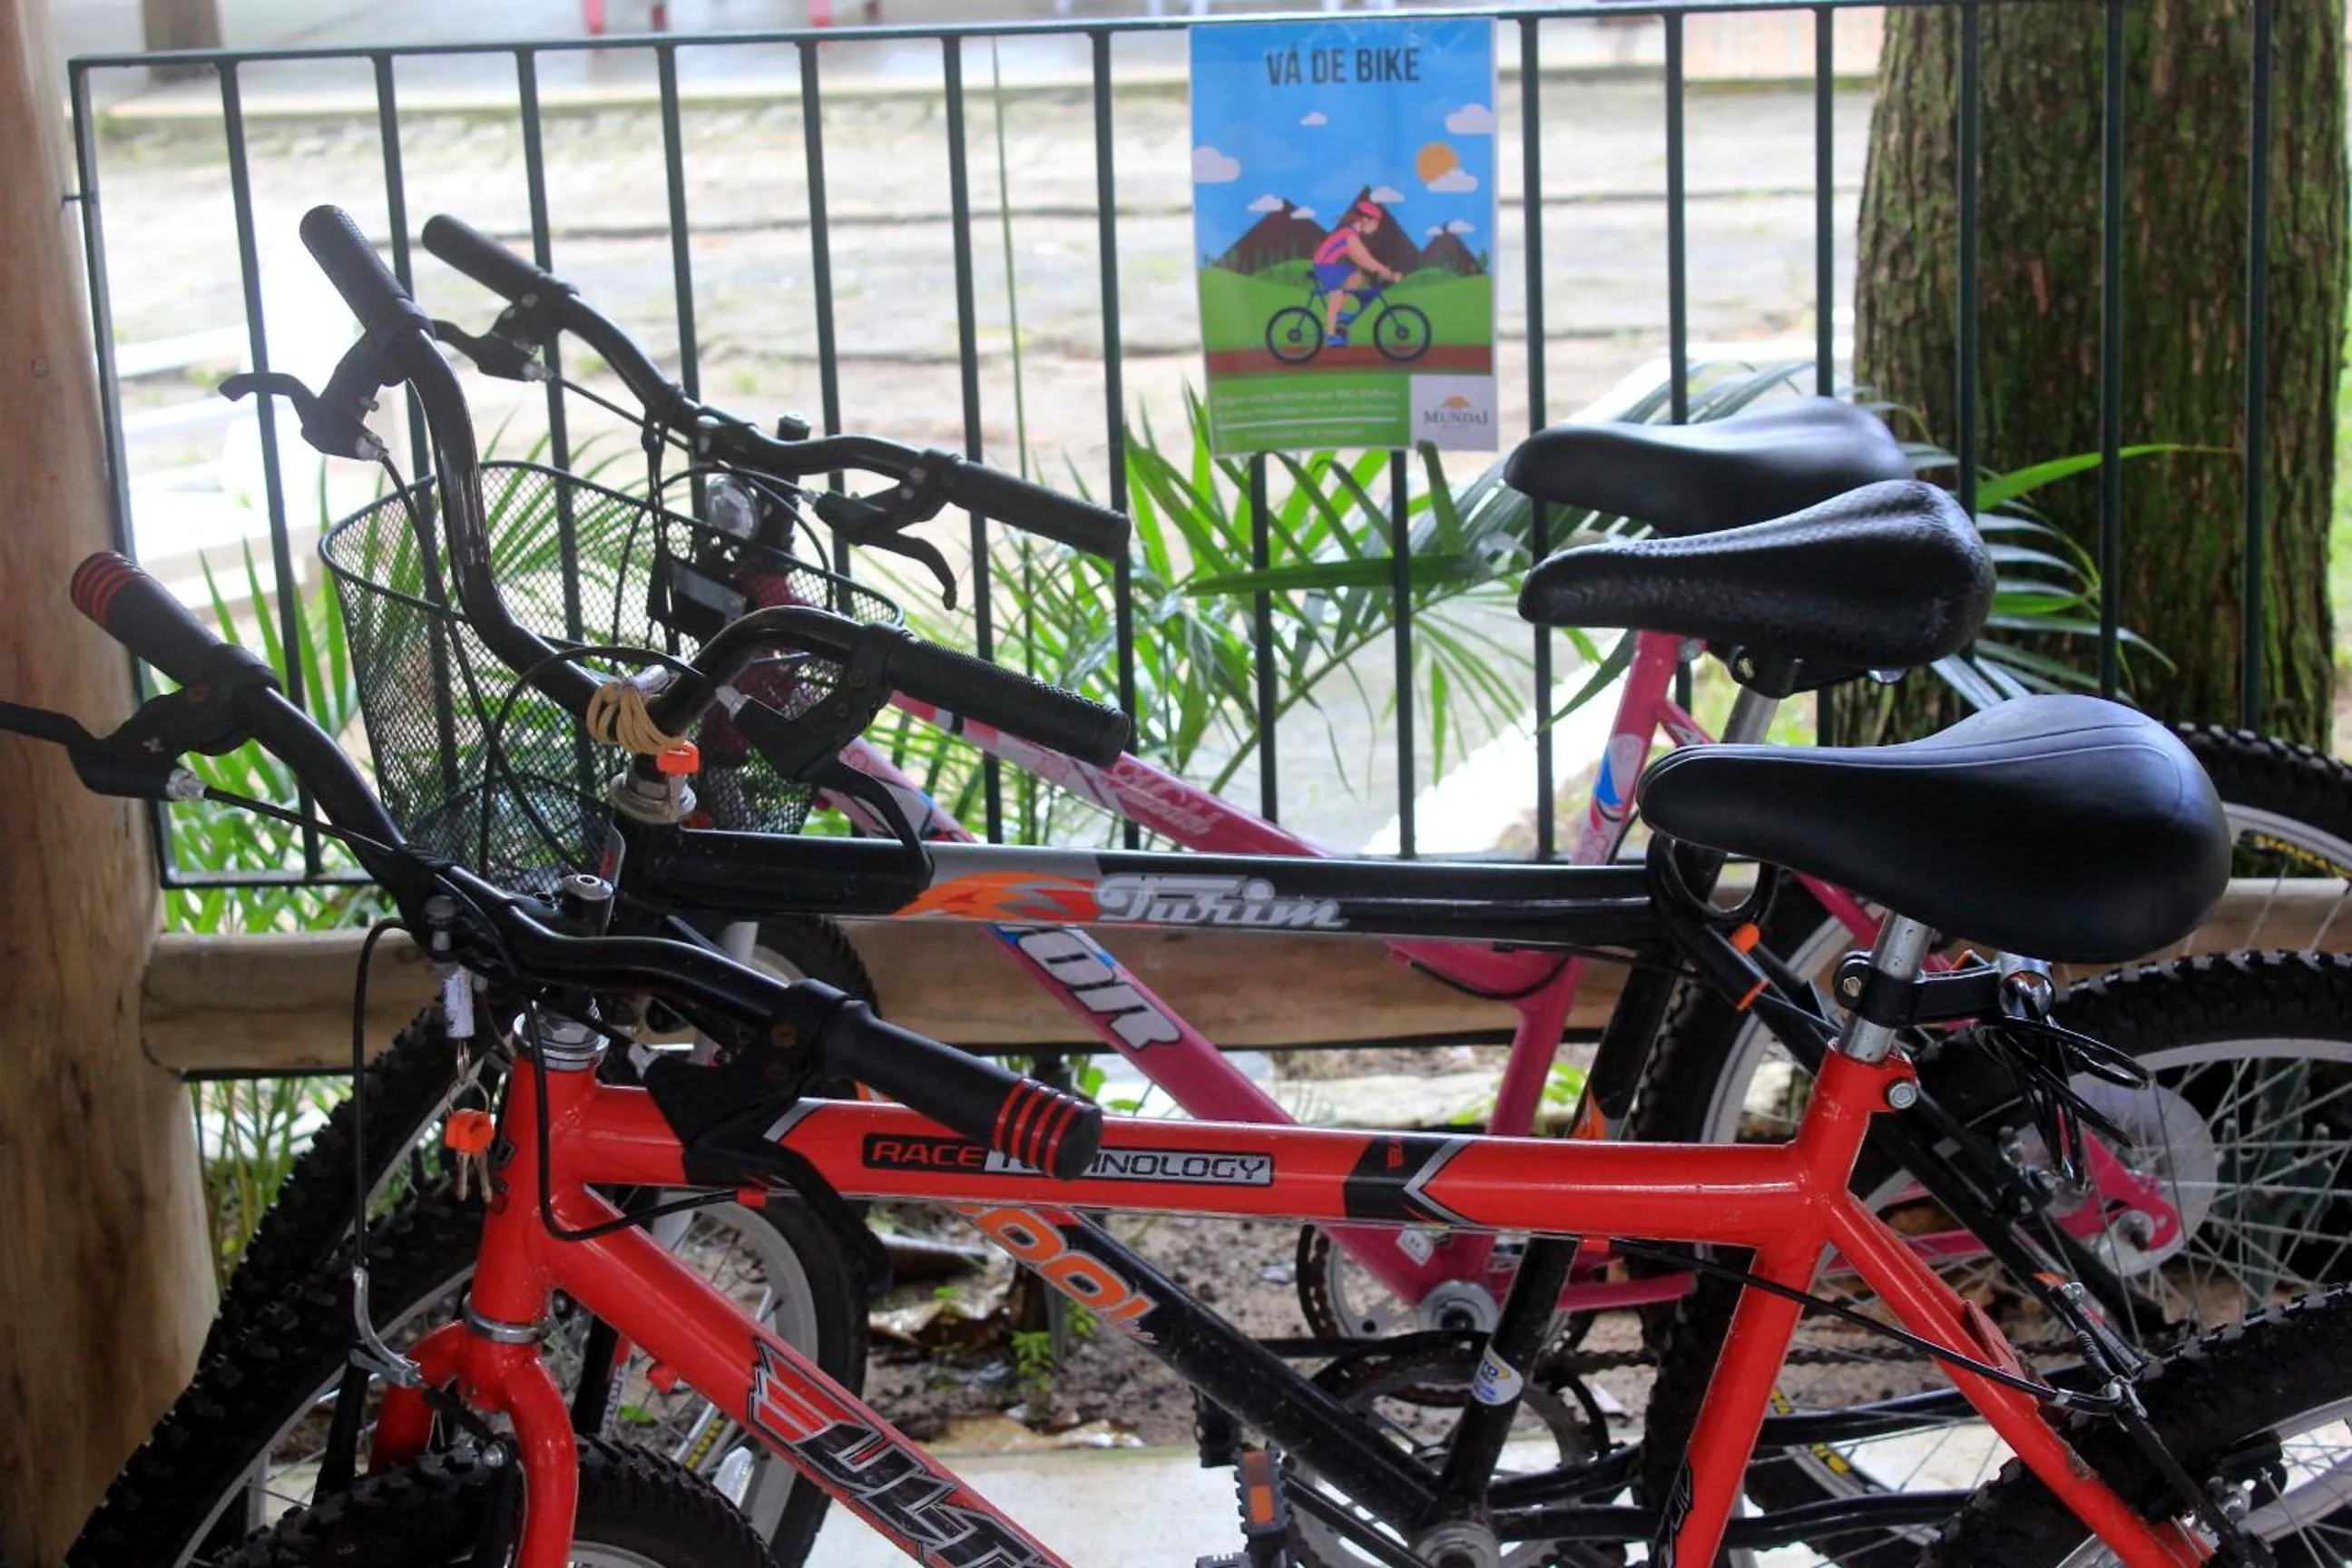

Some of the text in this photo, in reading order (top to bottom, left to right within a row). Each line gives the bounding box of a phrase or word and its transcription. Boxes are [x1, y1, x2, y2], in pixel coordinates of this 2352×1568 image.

[1266, 42, 1421, 86] VÁ DE BIKE
[1093, 873, 1350, 929] Turim
[872, 1140, 1266, 1181] RACE NOLOGY
